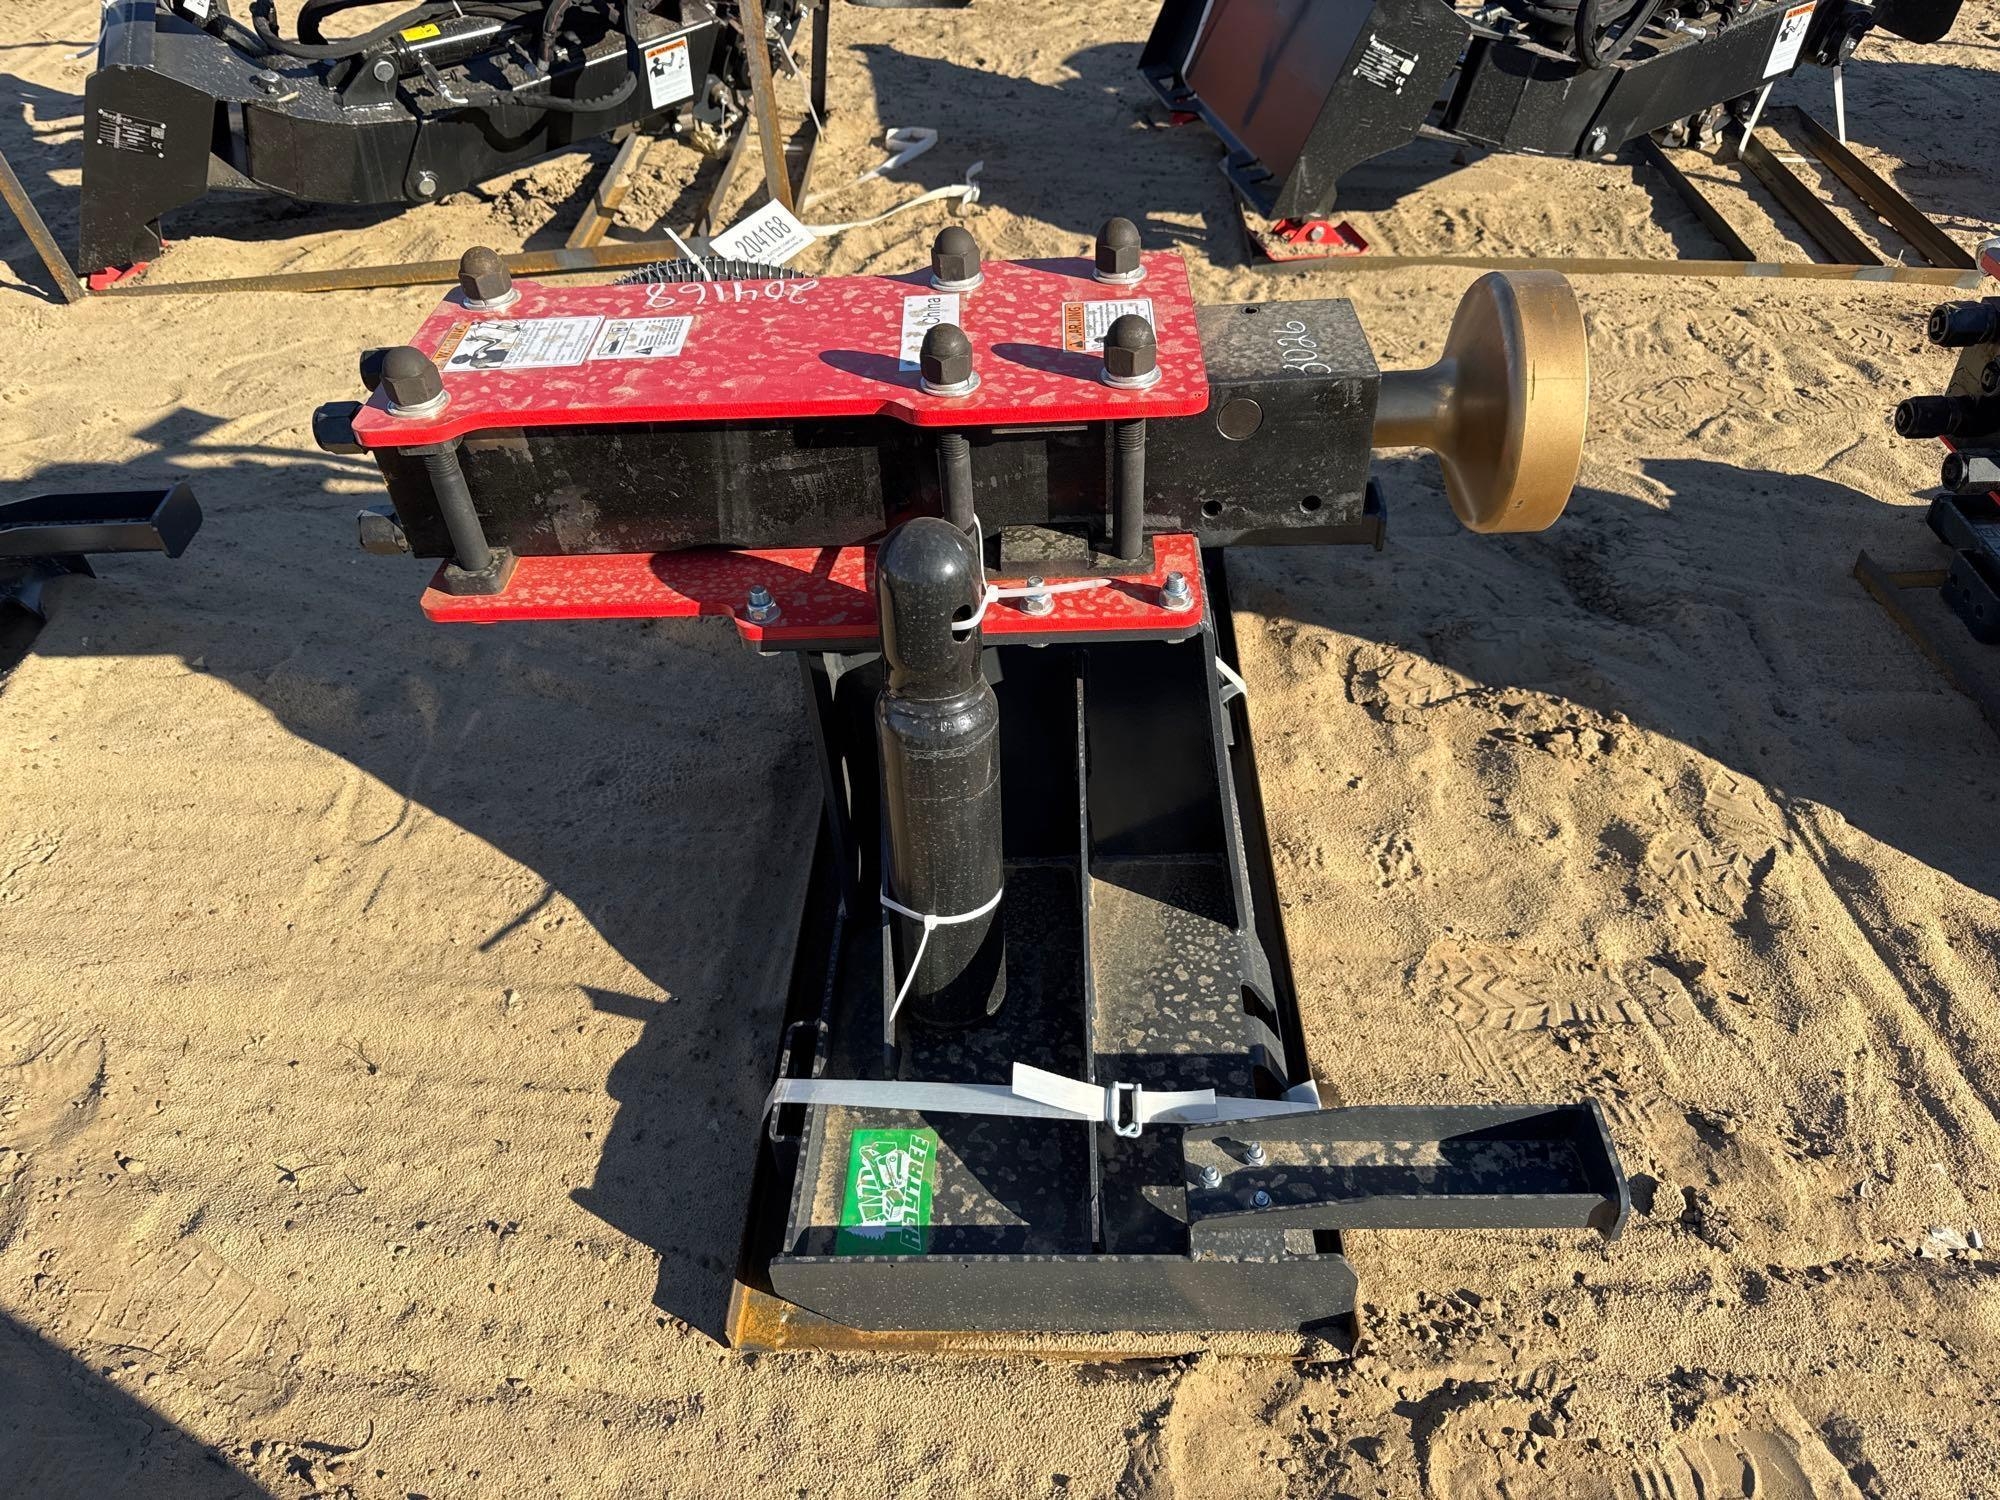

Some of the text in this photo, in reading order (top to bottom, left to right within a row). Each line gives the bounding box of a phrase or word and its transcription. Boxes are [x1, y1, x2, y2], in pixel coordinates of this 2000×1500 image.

[735, 216, 792, 258] 204168
[646, 279, 820, 309] 204168
[924, 297, 941, 325] China
[1068, 306, 1082, 341] ARNING
[1273, 320, 1332, 375] 3026
[900, 1135, 930, 1250] RAYTREE
